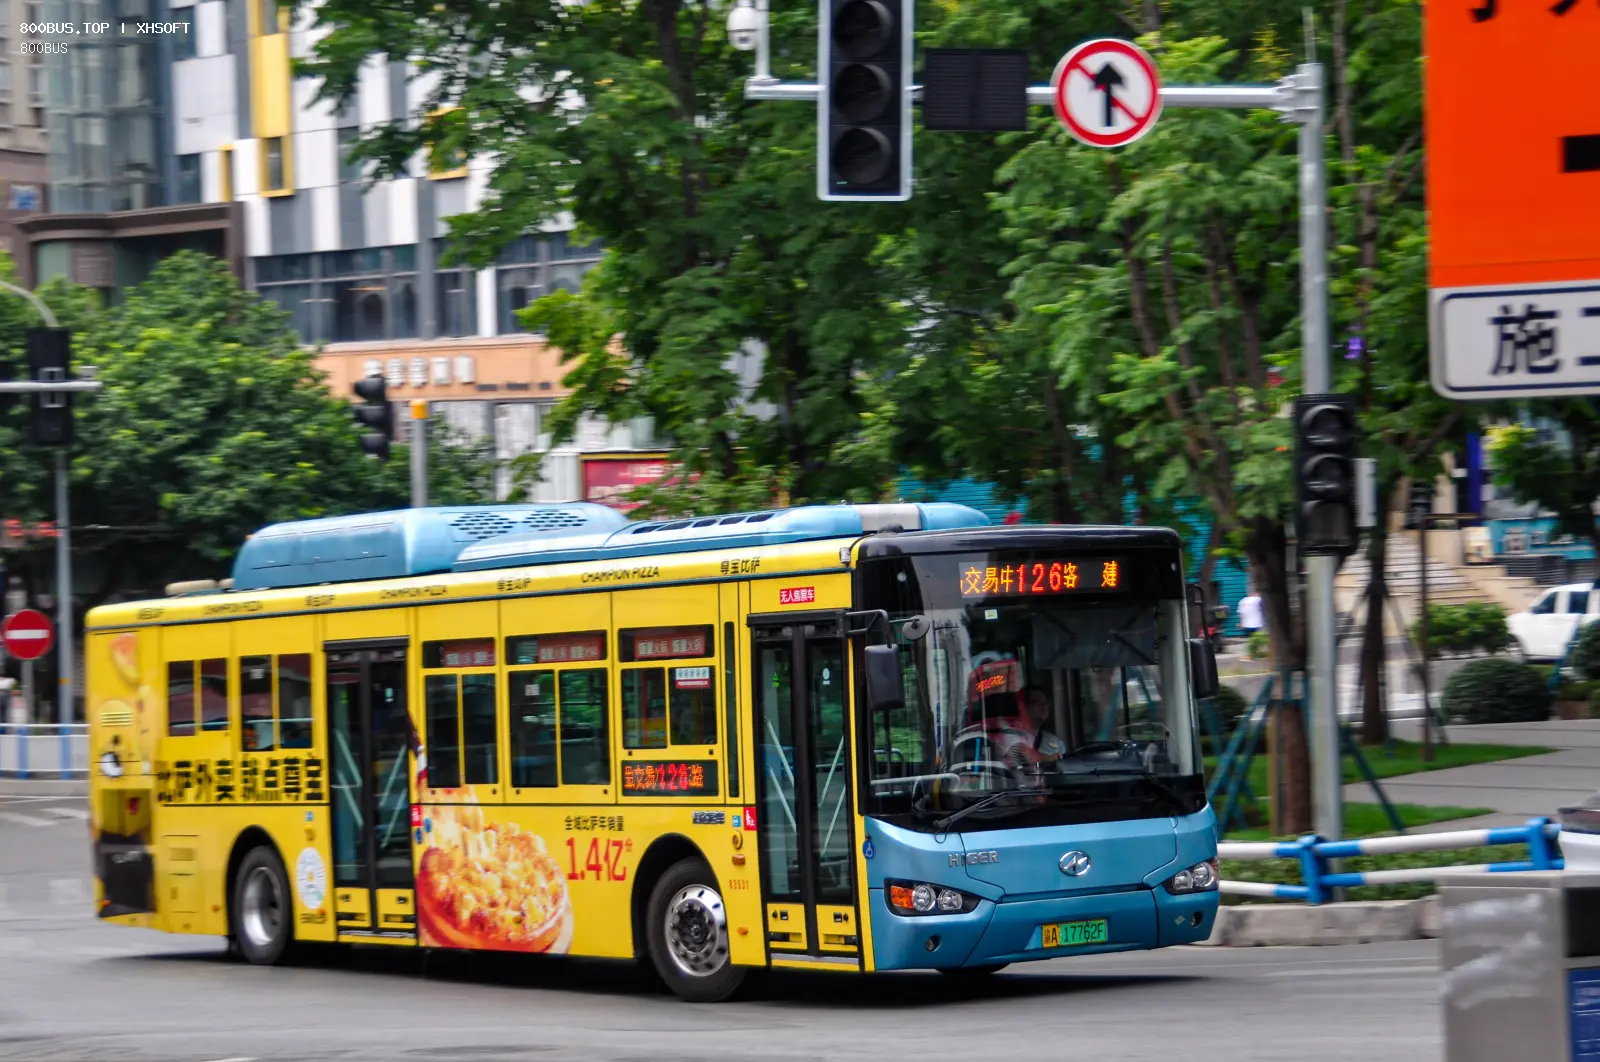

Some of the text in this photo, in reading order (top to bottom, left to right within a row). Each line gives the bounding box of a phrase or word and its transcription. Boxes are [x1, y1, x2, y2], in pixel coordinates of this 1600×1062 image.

[720, 556, 760, 575] 尊宝比萨
[581, 566, 660, 583] CHAMPION PIZZA
[780, 588, 815, 603] 无人售票车
[948, 850, 999, 867] HIGER
